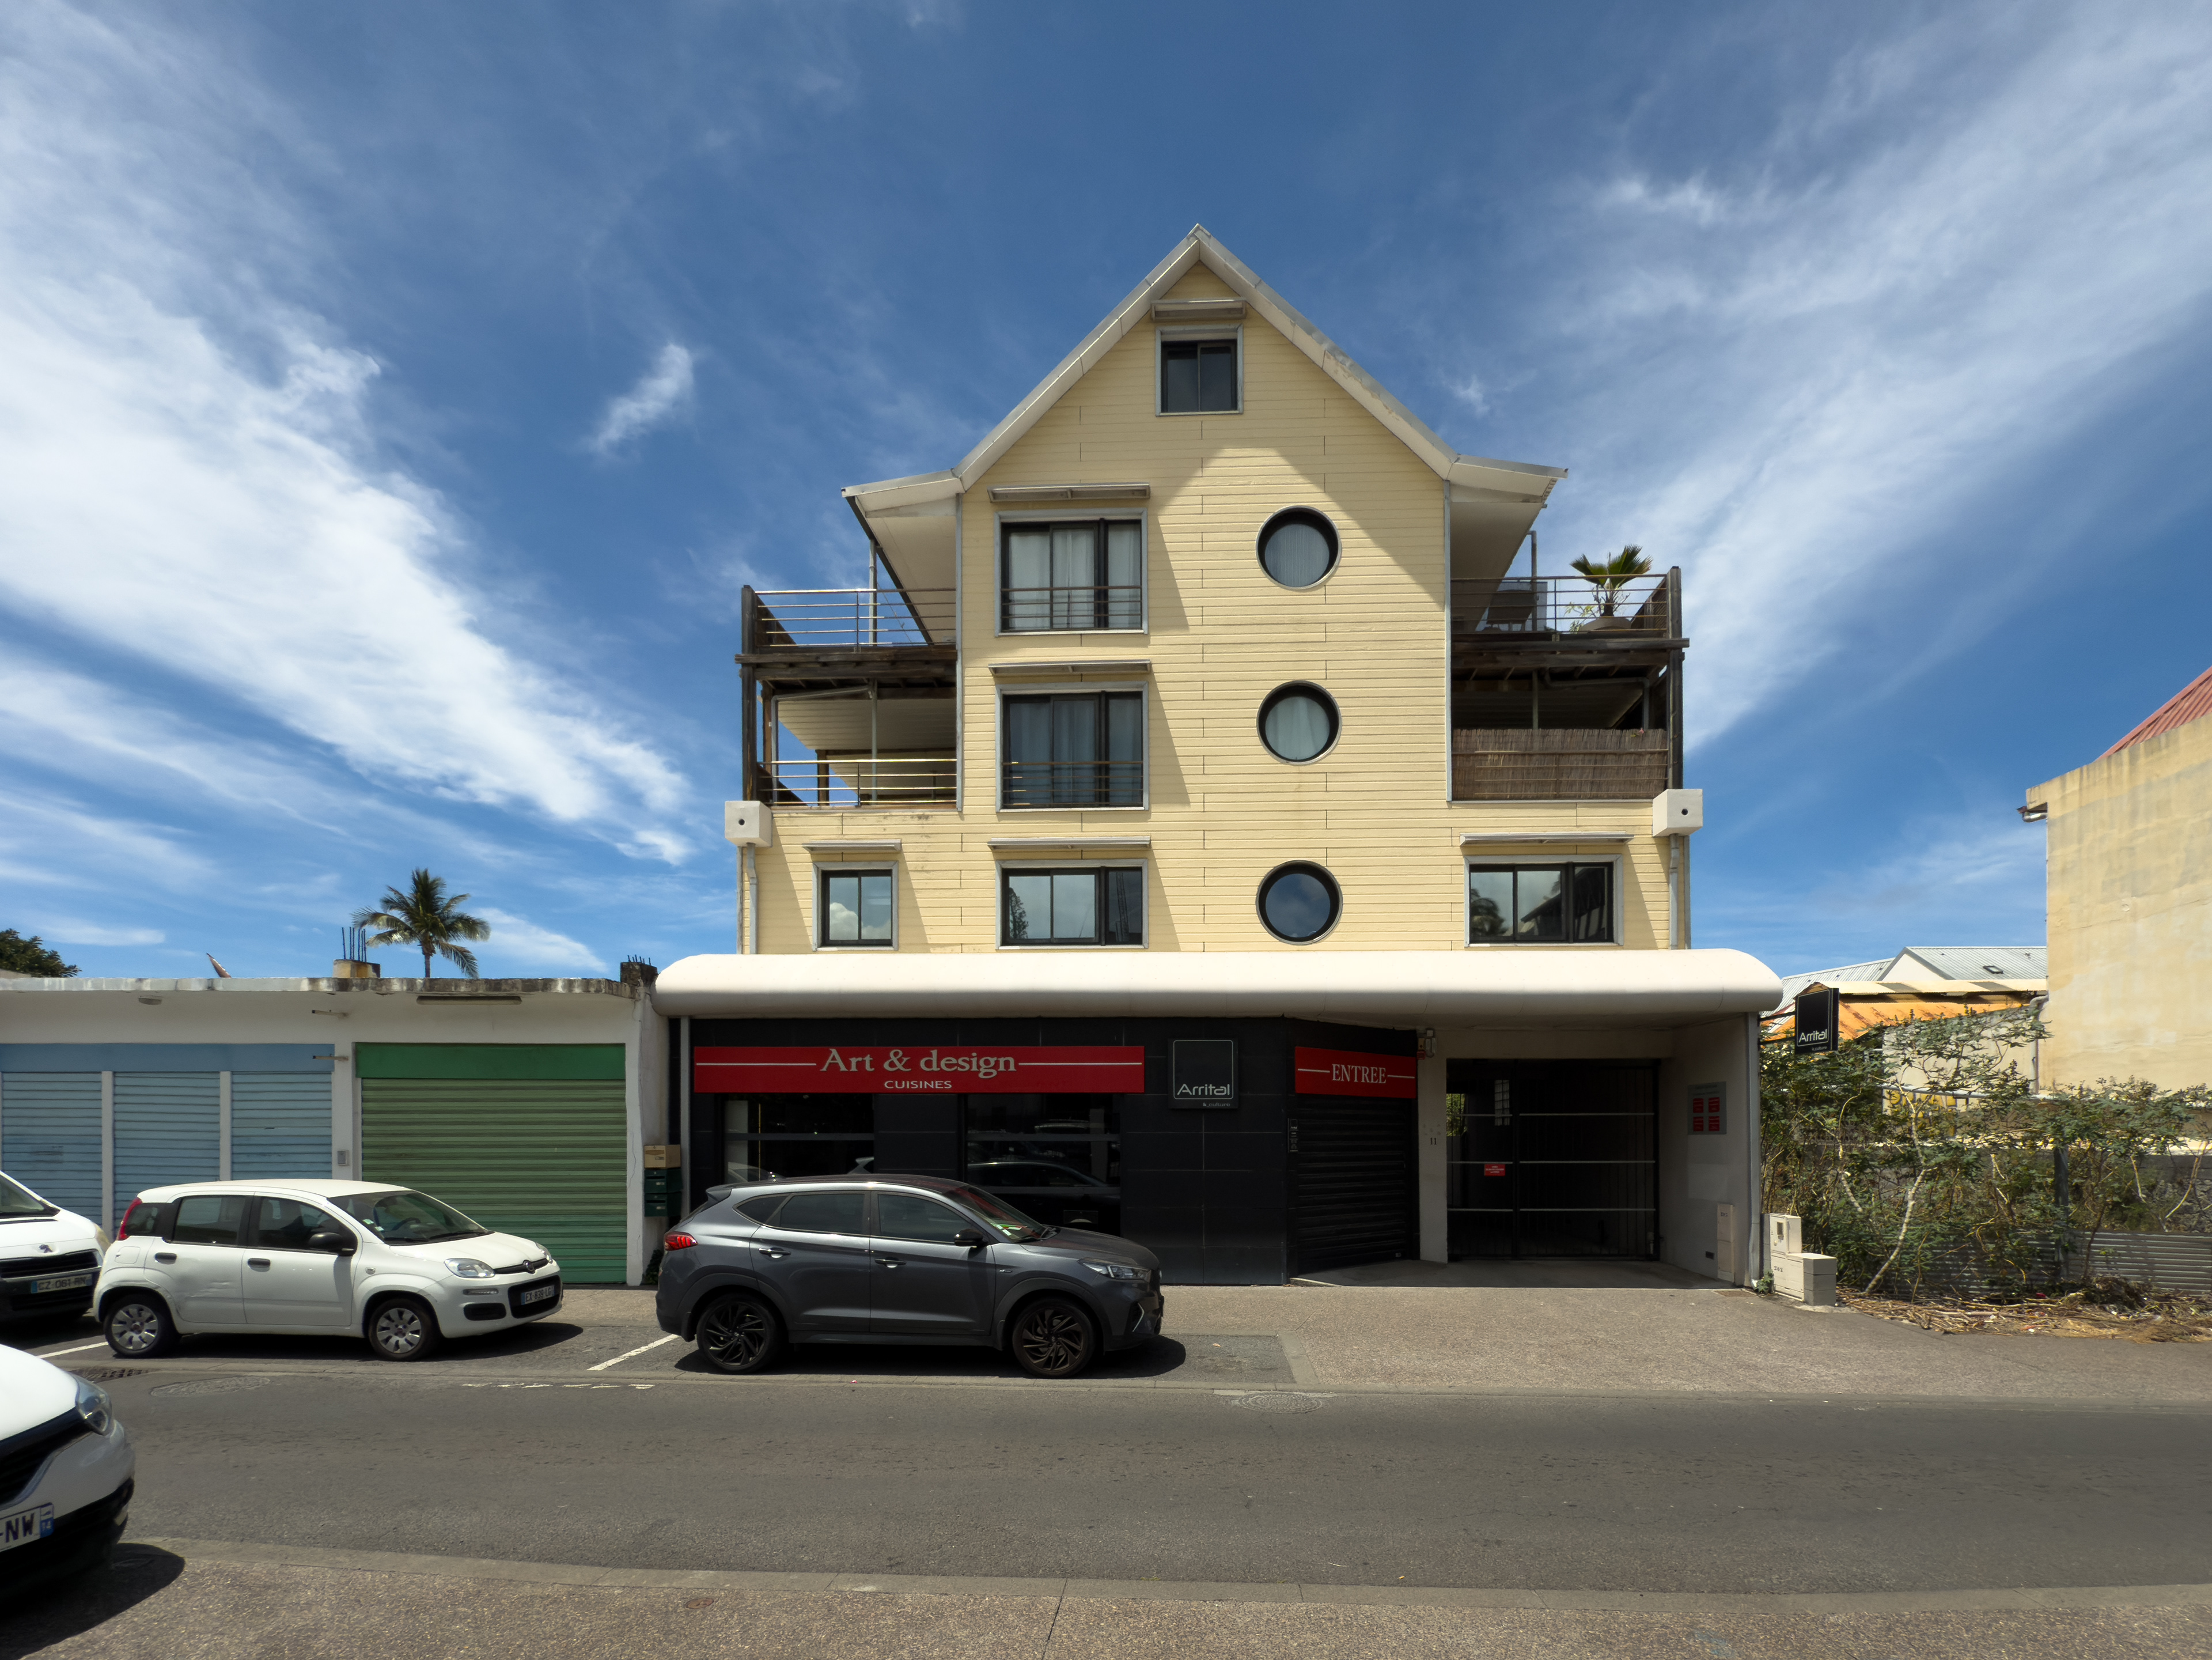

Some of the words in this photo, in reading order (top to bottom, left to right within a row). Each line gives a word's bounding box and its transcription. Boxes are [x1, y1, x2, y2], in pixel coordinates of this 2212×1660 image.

[1798, 1028, 1827, 1043] Arrital
[820, 1048, 874, 1072] Art
[884, 1049, 911, 1072] &
[920, 1049, 1016, 1079] design
[1332, 1064, 1387, 1084] ENTREE
[884, 1080, 952, 1089] CUISINES
[1177, 1083, 1230, 1096] Arrital
[1430, 1137, 1437, 1145] 11
